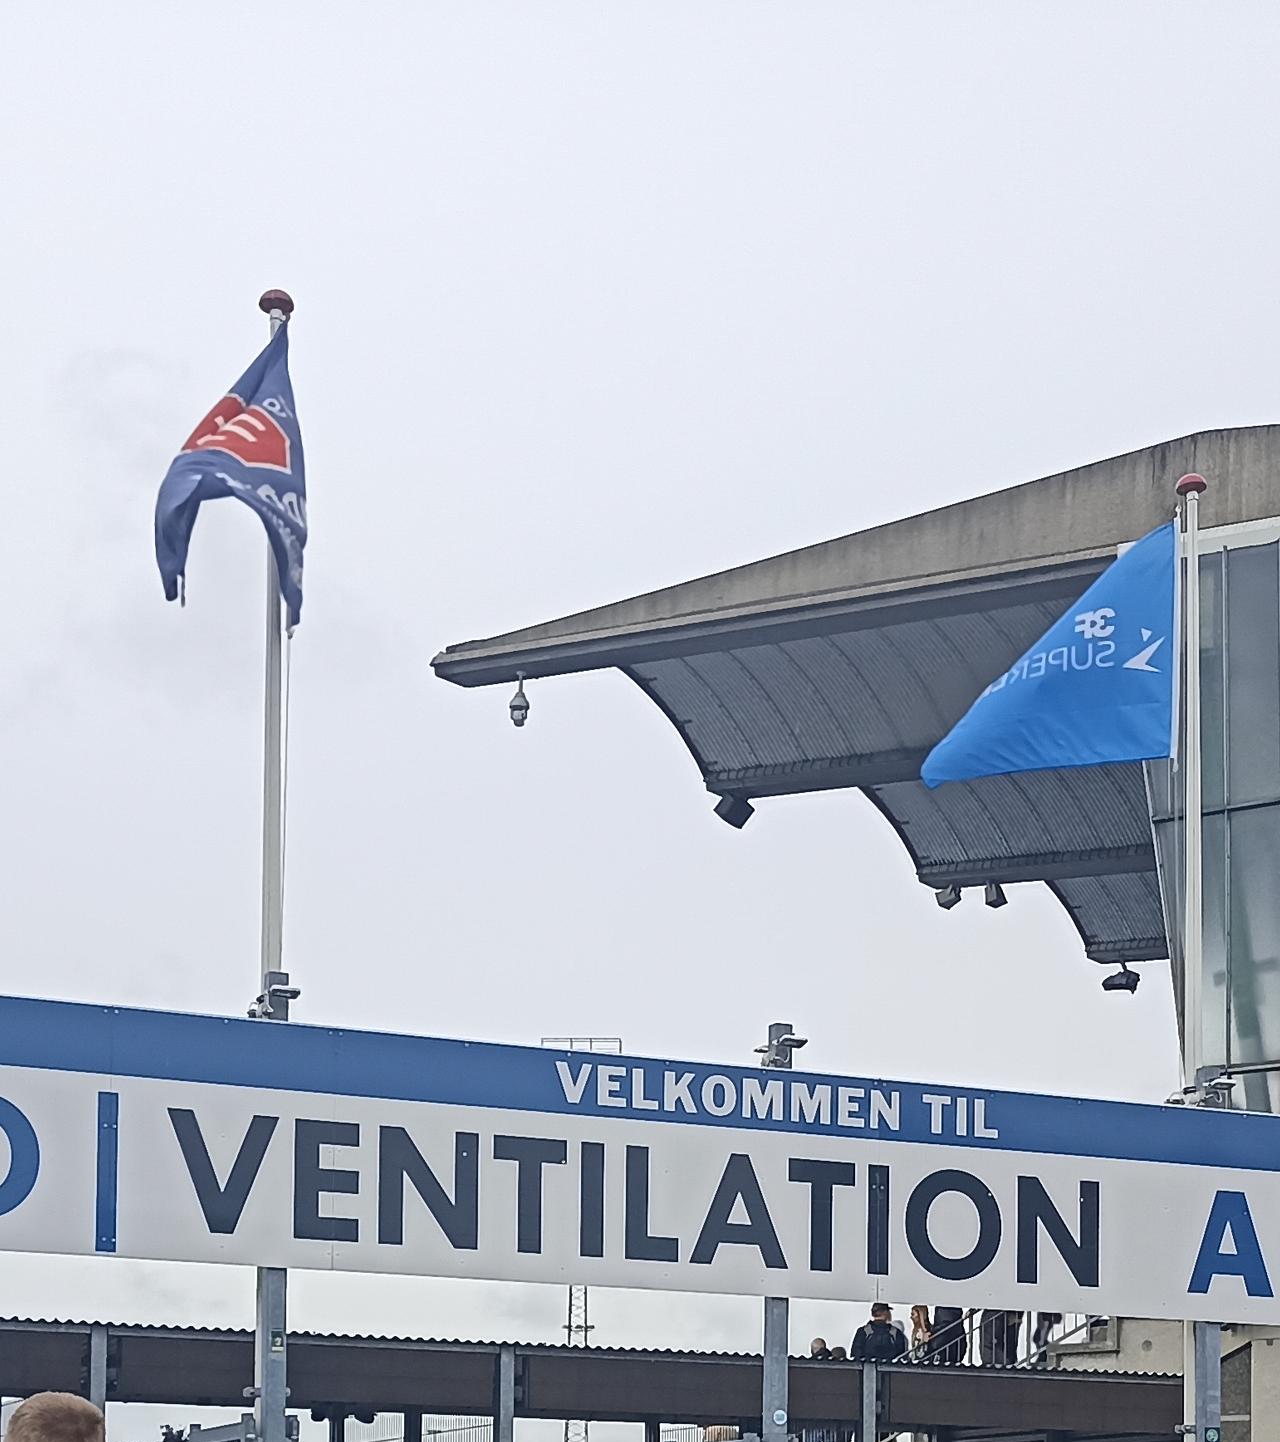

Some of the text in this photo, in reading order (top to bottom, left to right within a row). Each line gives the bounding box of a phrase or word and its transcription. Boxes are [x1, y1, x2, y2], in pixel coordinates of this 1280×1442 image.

[553, 1060, 1000, 1141] VELKOMMEN TIL
[165, 1106, 1101, 1288] VENTILATION
